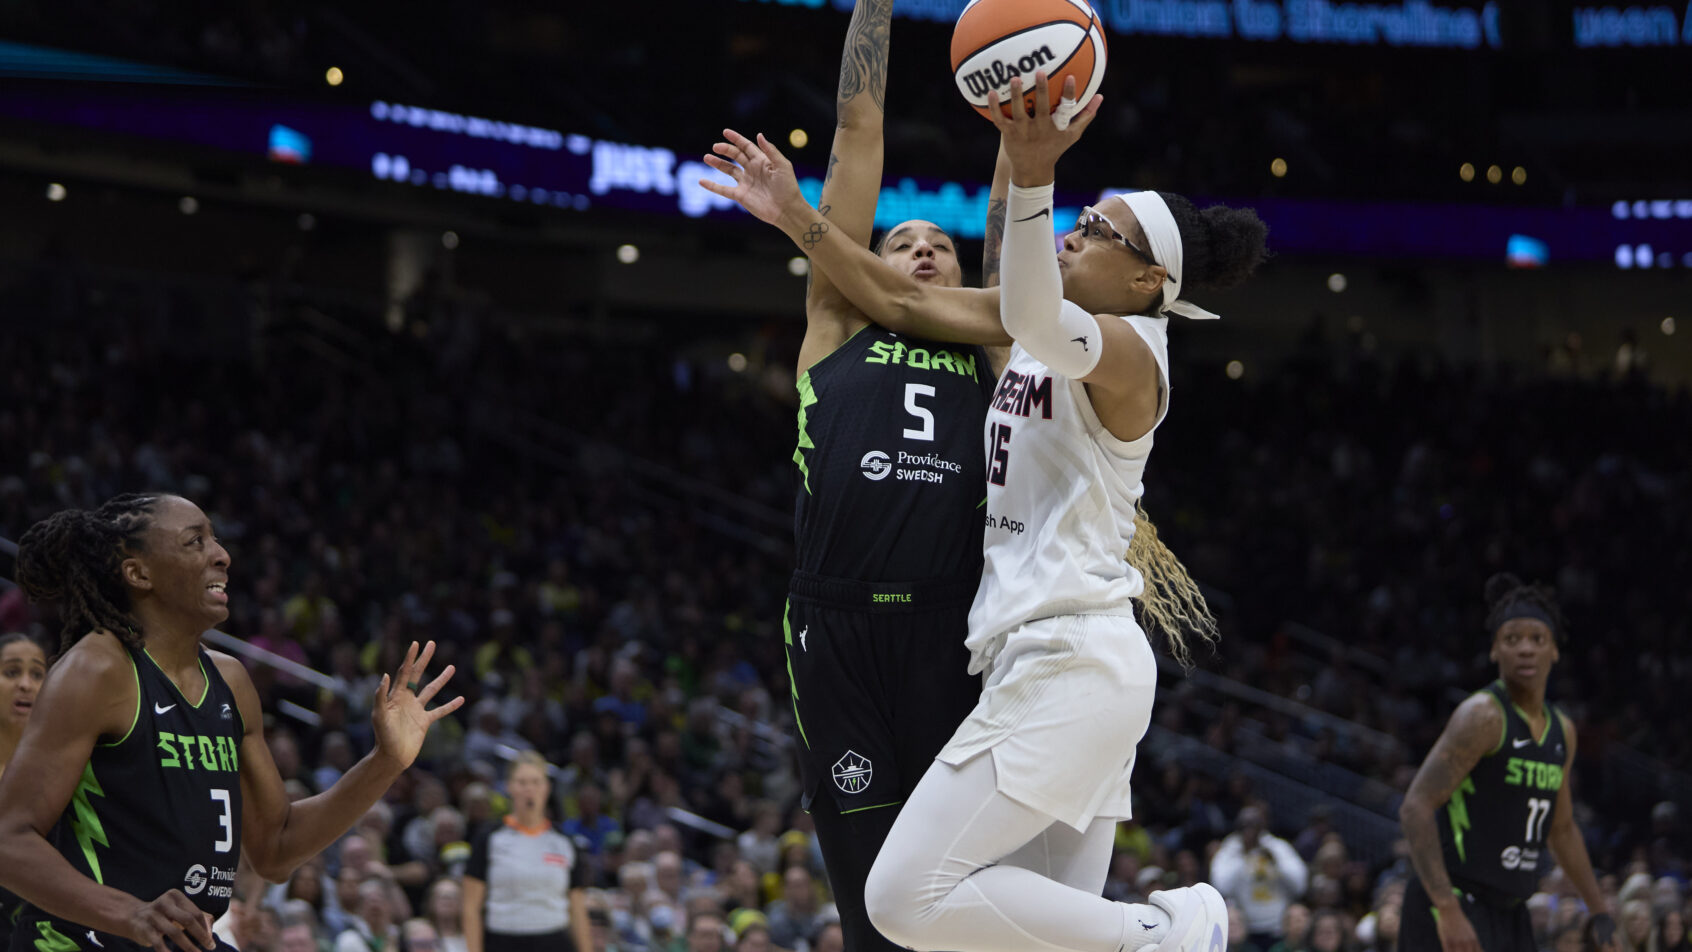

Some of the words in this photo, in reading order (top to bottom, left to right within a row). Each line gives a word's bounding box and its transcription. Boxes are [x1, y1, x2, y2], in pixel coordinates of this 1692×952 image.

[963, 45, 1056, 98] Wilson
[865, 341, 979, 384] STORM
[903, 383, 936, 441] 5
[991, 369, 1053, 420] REAM
[897, 451, 962, 474] Providence
[986, 422, 1012, 487] 15
[1000, 516, 1025, 535] App
[872, 593, 912, 602] SEATTLE
[210, 788, 233, 853] 3
